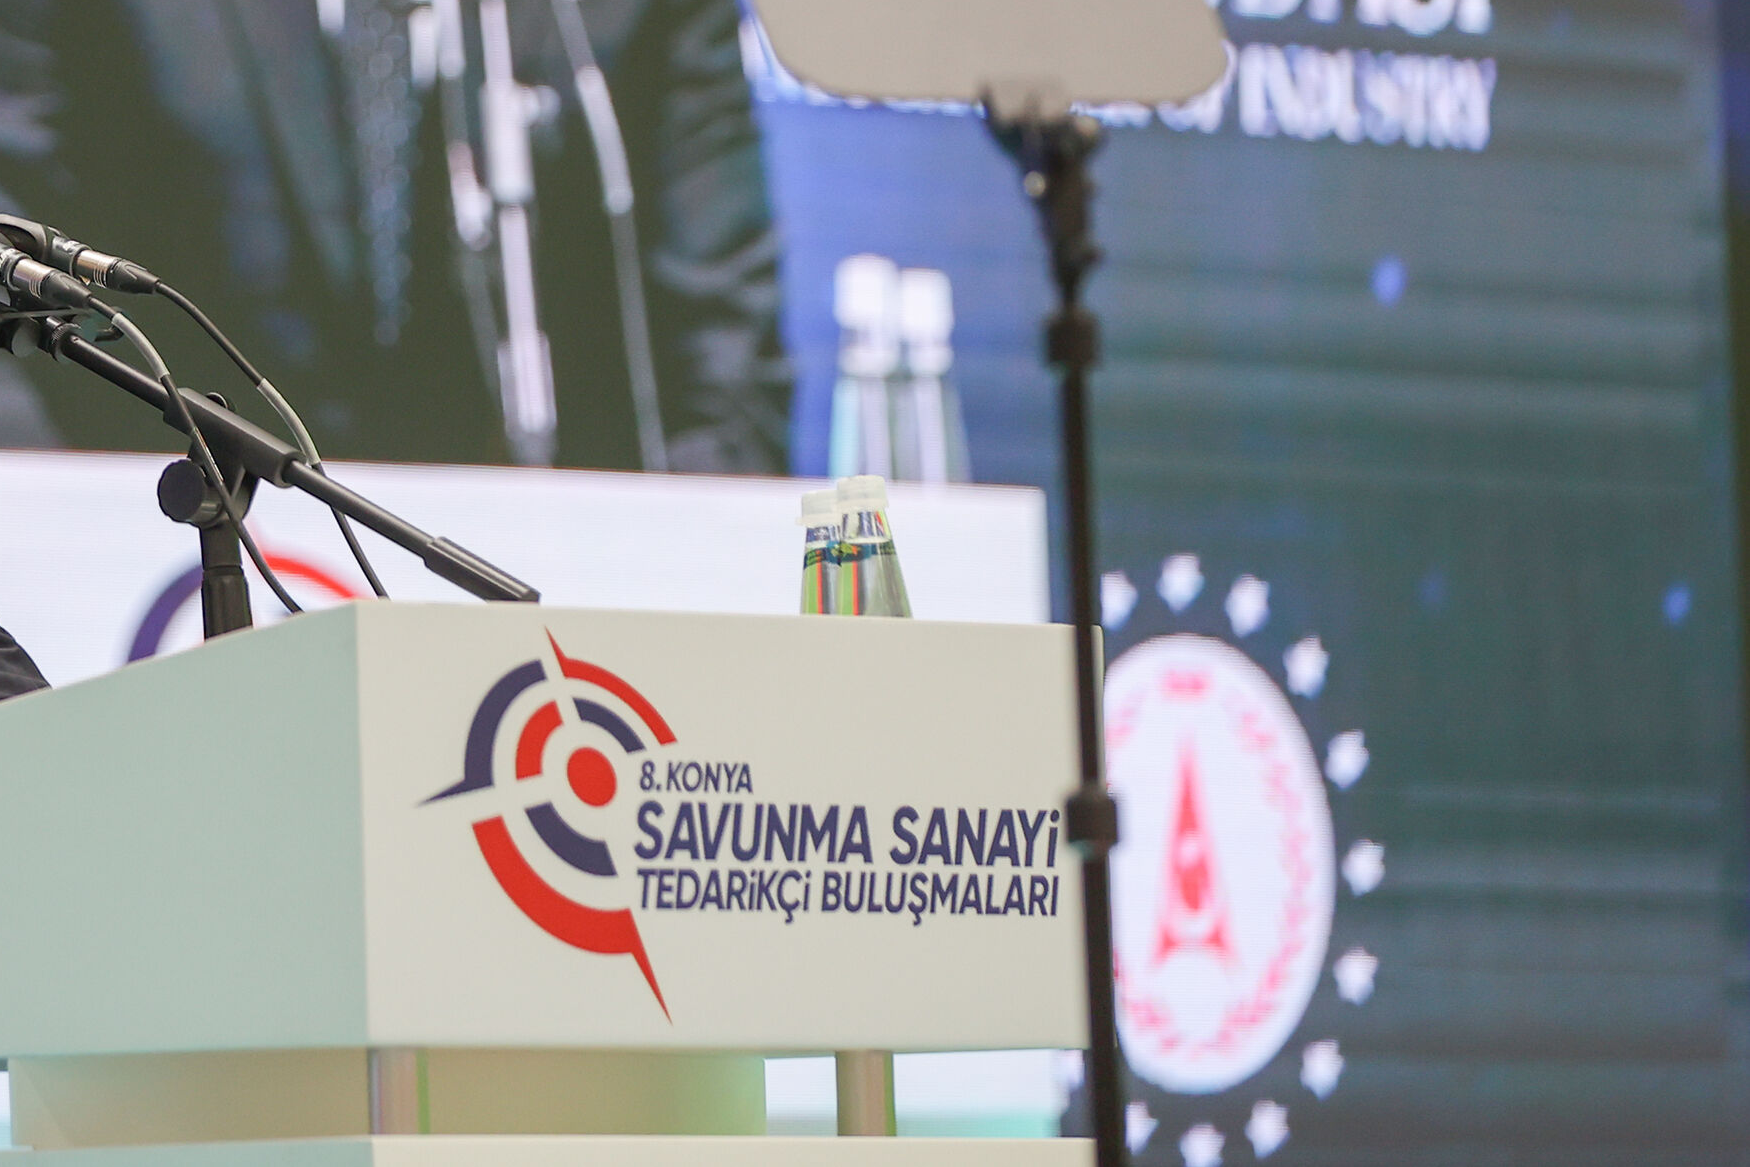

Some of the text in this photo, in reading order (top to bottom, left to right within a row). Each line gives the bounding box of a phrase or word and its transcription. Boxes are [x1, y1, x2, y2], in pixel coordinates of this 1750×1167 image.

[640, 760, 754, 794] 8. KONYA
[633, 800, 873, 865] SAVUNMA
[820, 870, 1060, 927] BULUŞMALARI
